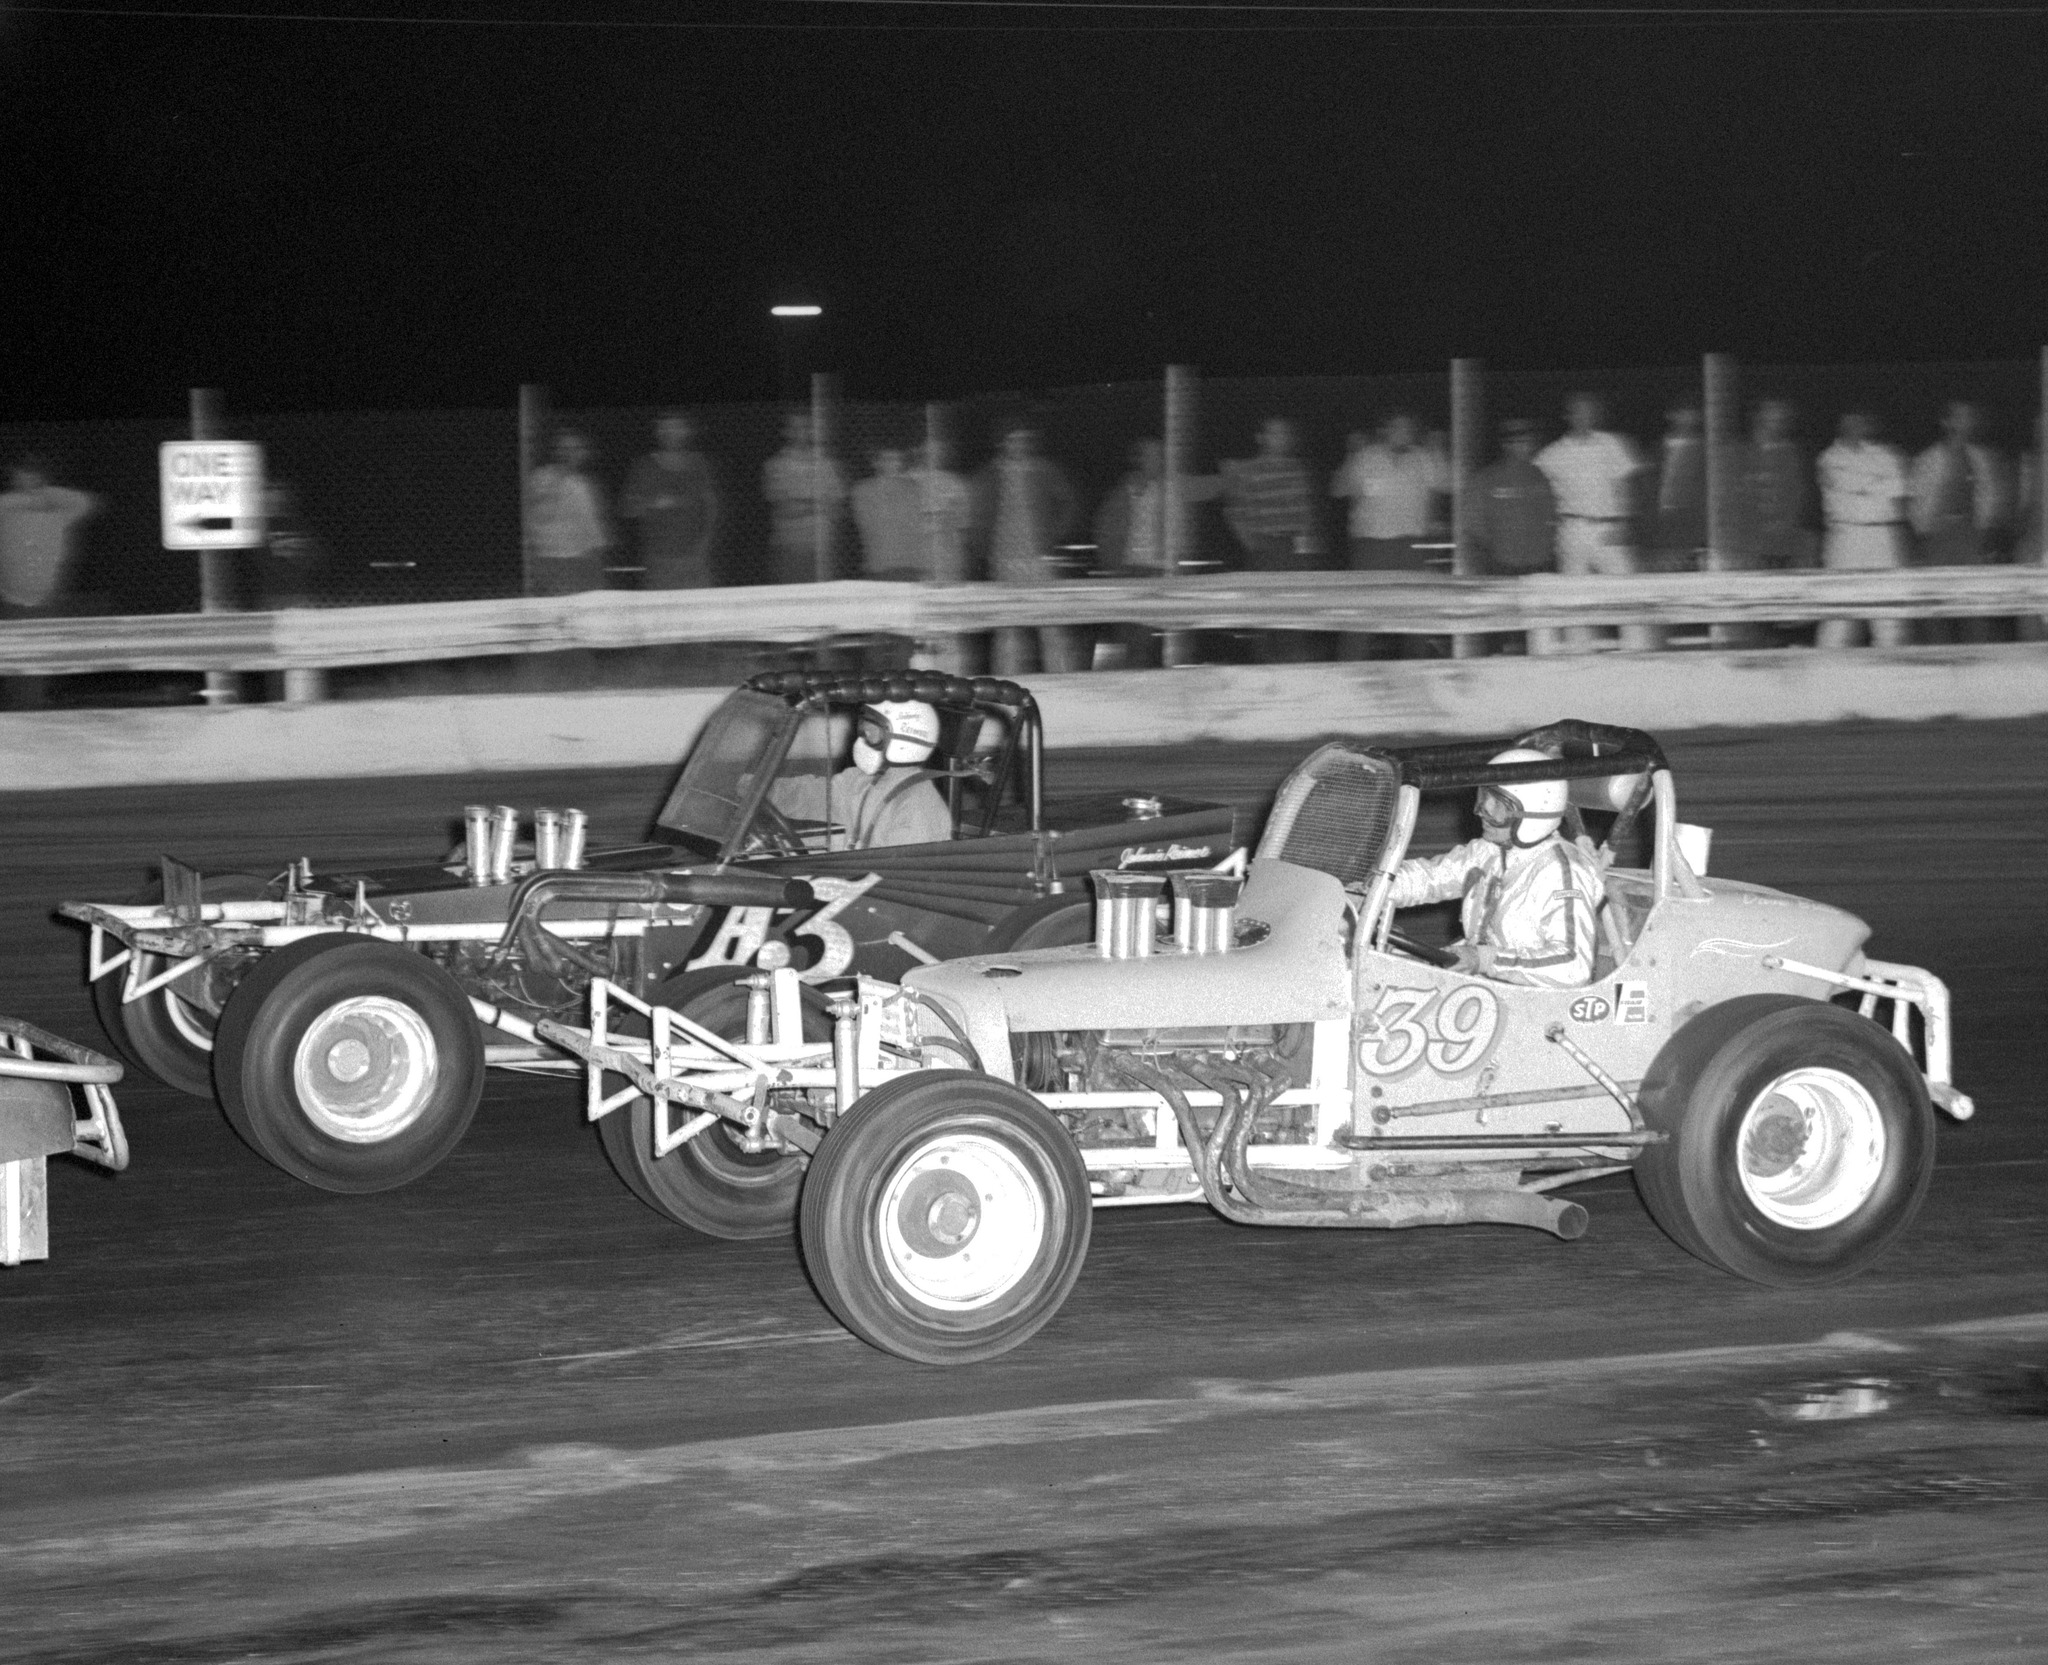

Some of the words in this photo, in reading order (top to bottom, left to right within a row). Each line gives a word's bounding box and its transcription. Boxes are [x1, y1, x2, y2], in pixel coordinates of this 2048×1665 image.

[171, 452, 238, 477] ONE
[170, 481, 233, 505] WAY
[1572, 996, 1607, 1020] STP
[1358, 983, 1499, 1078] 39
